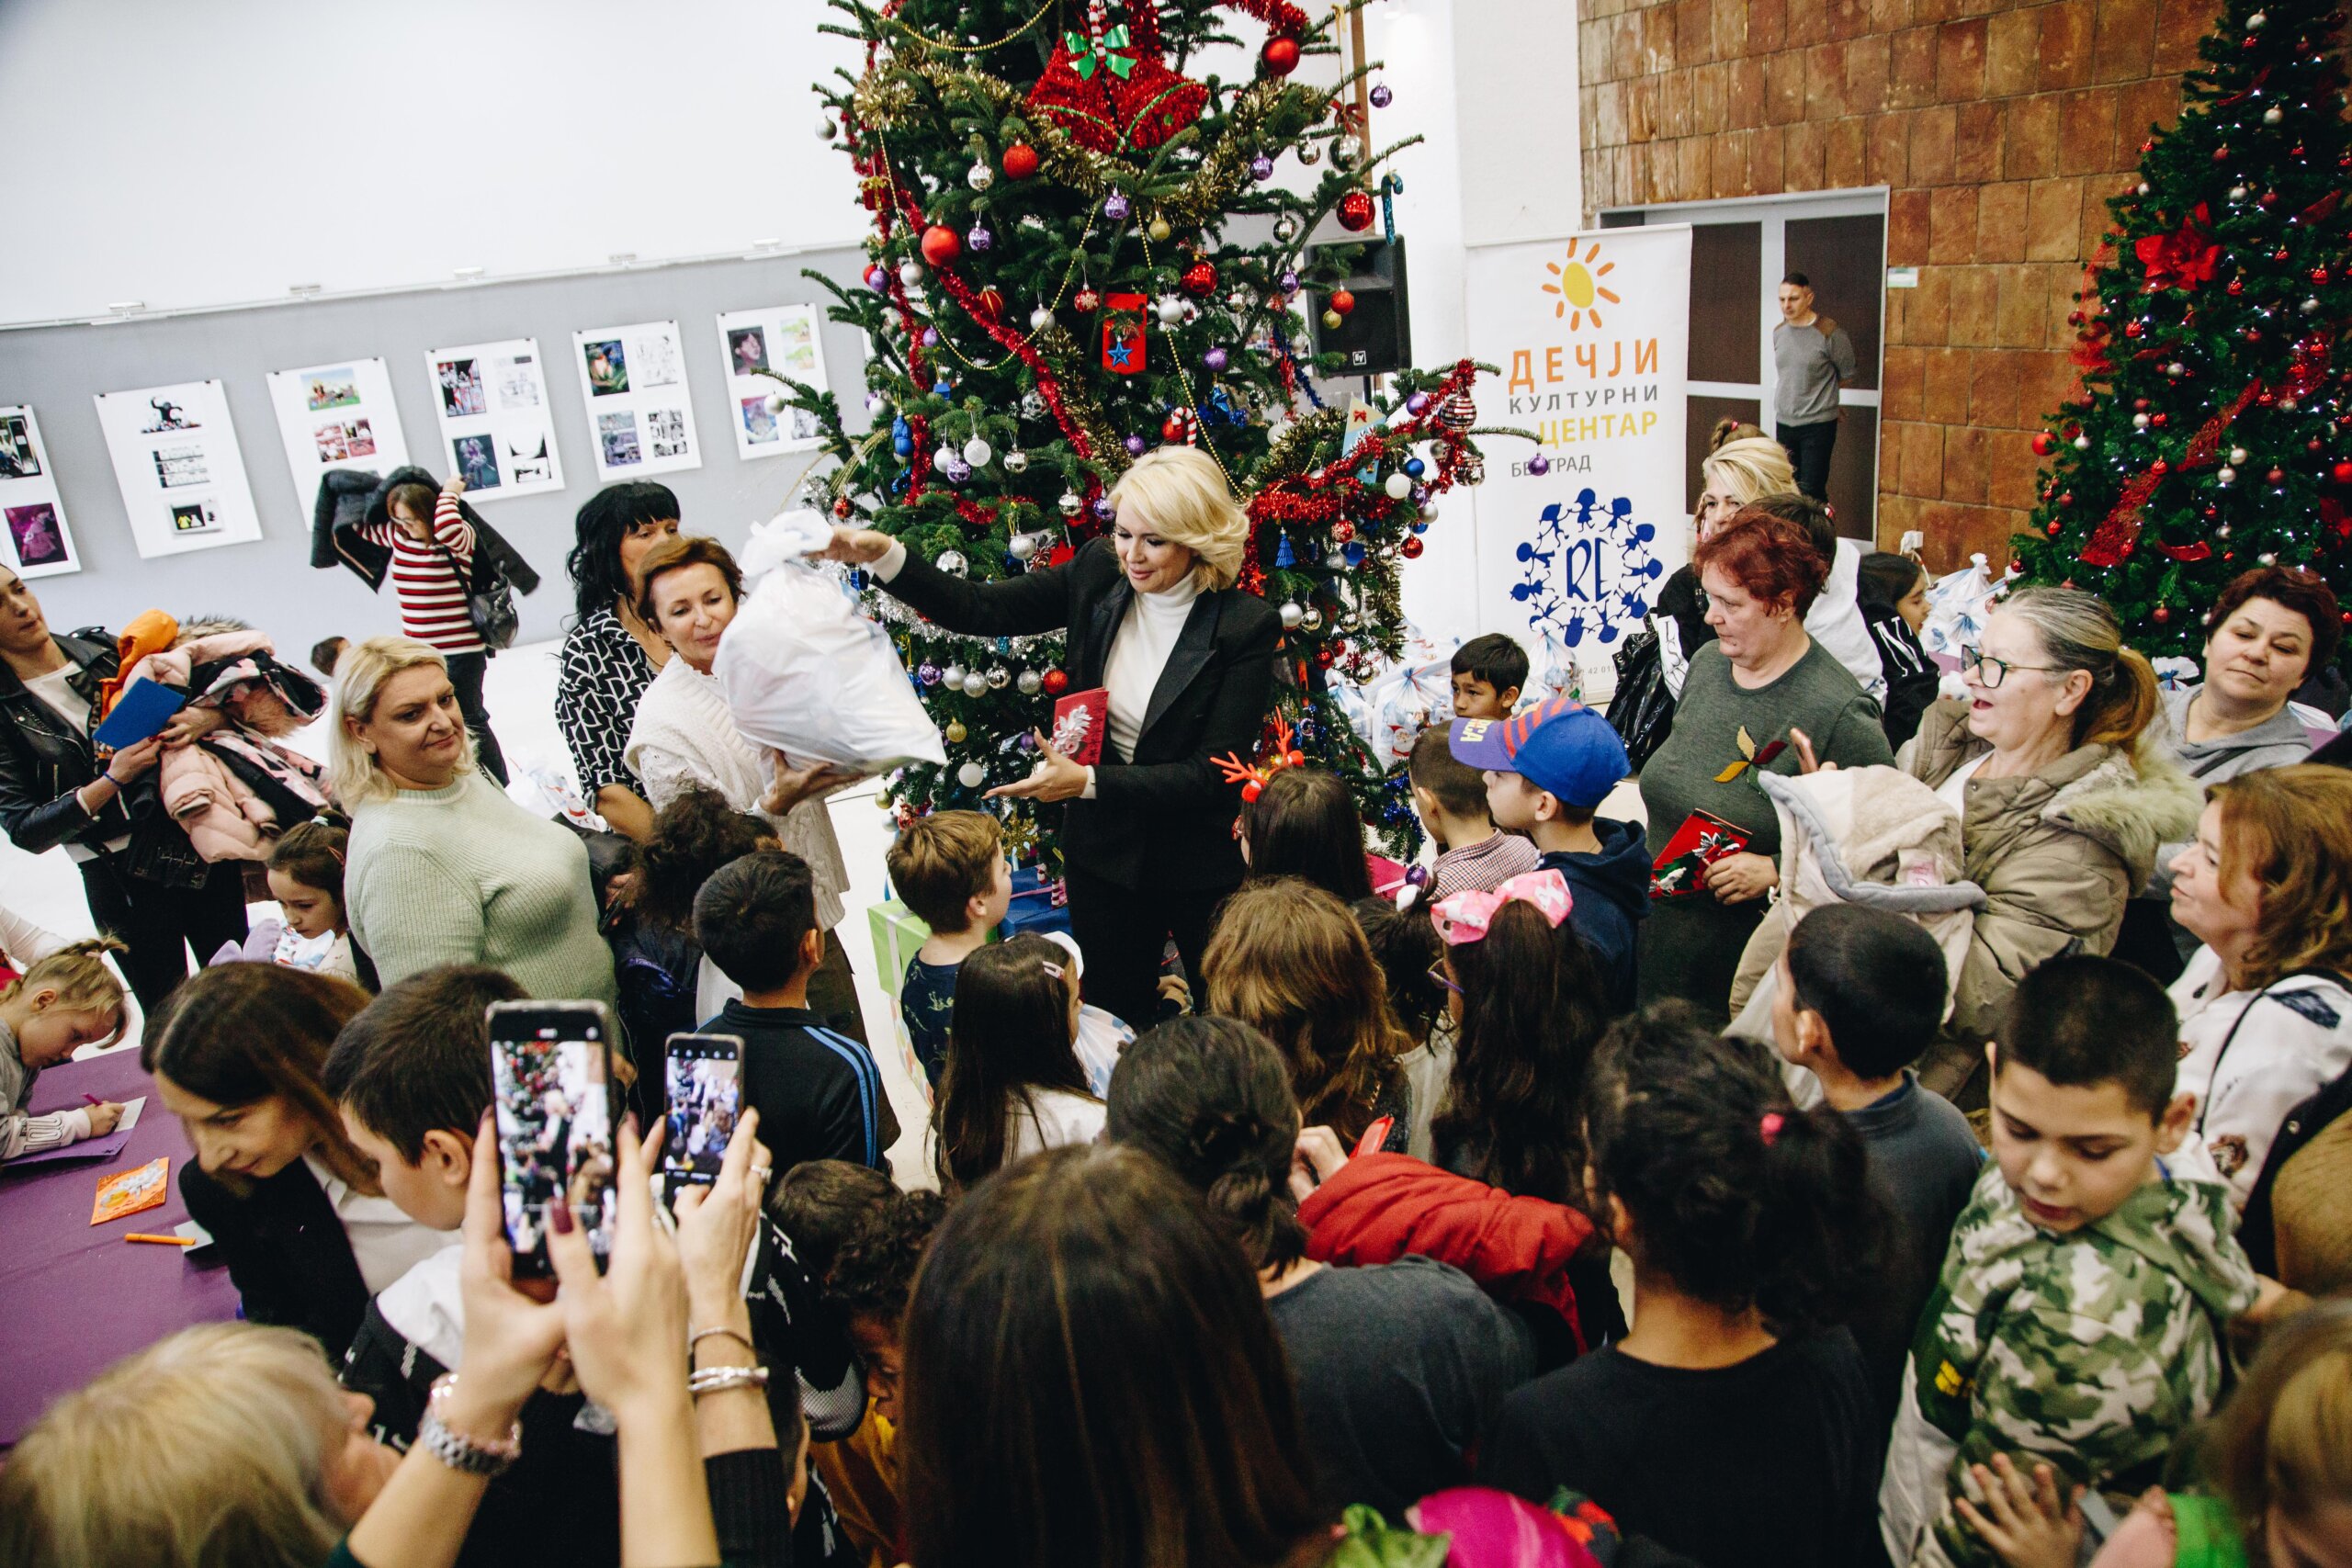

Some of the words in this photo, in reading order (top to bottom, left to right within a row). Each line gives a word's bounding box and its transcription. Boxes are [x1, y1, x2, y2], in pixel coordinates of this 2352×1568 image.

[1509, 338, 1657, 395] ДЕЧЈИ
[1510, 385, 1657, 414] КУЛТУРНИ
[1539, 411, 1657, 449] ЦЕНТАР
[1511, 455, 1591, 478] БЕГРАД
